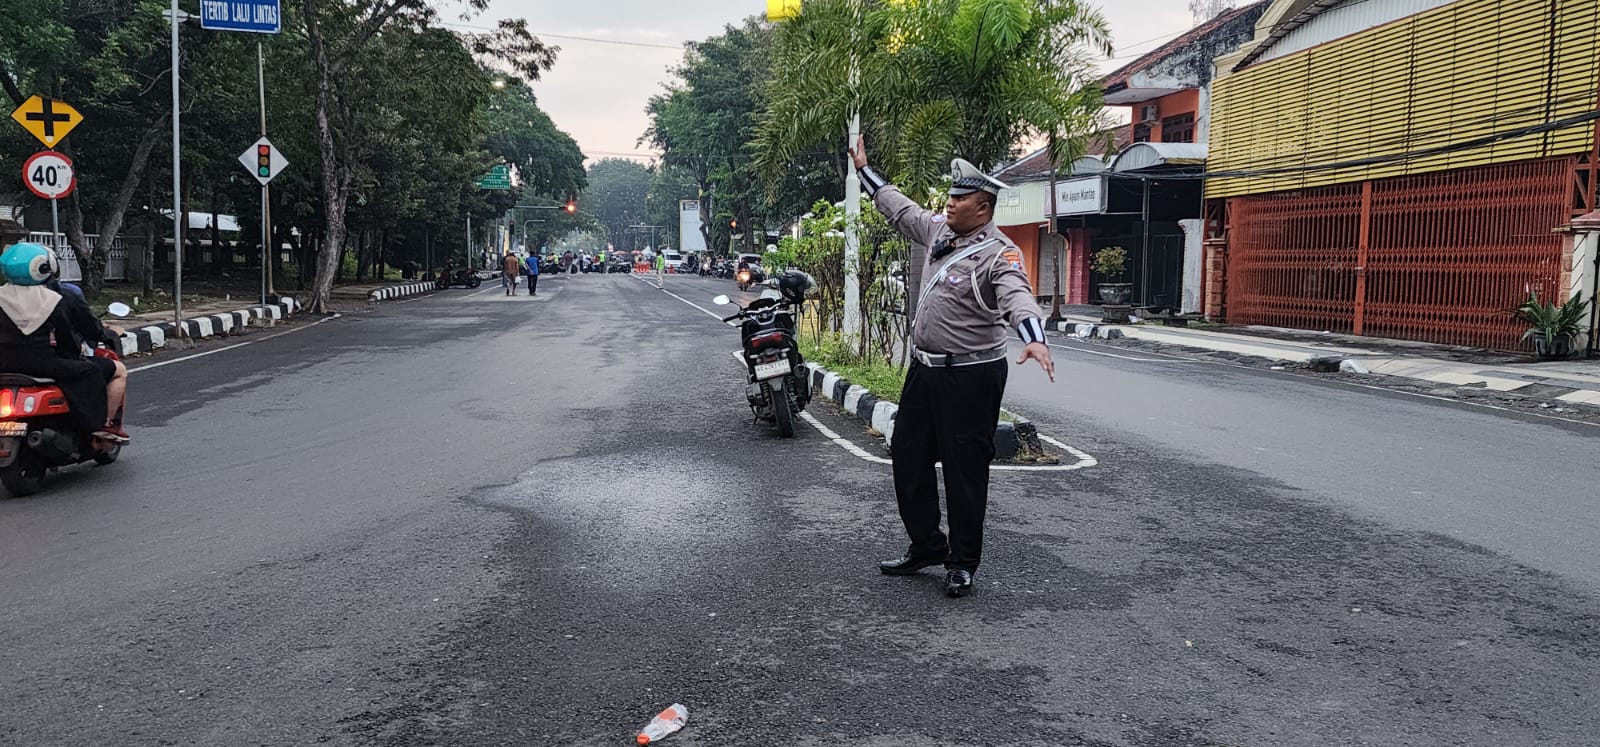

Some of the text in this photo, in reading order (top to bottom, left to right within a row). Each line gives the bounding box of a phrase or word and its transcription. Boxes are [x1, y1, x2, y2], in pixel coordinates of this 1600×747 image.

[203, 0, 277, 25] TERTIB LALU LINTAS
[32, 165, 57, 186] 40
